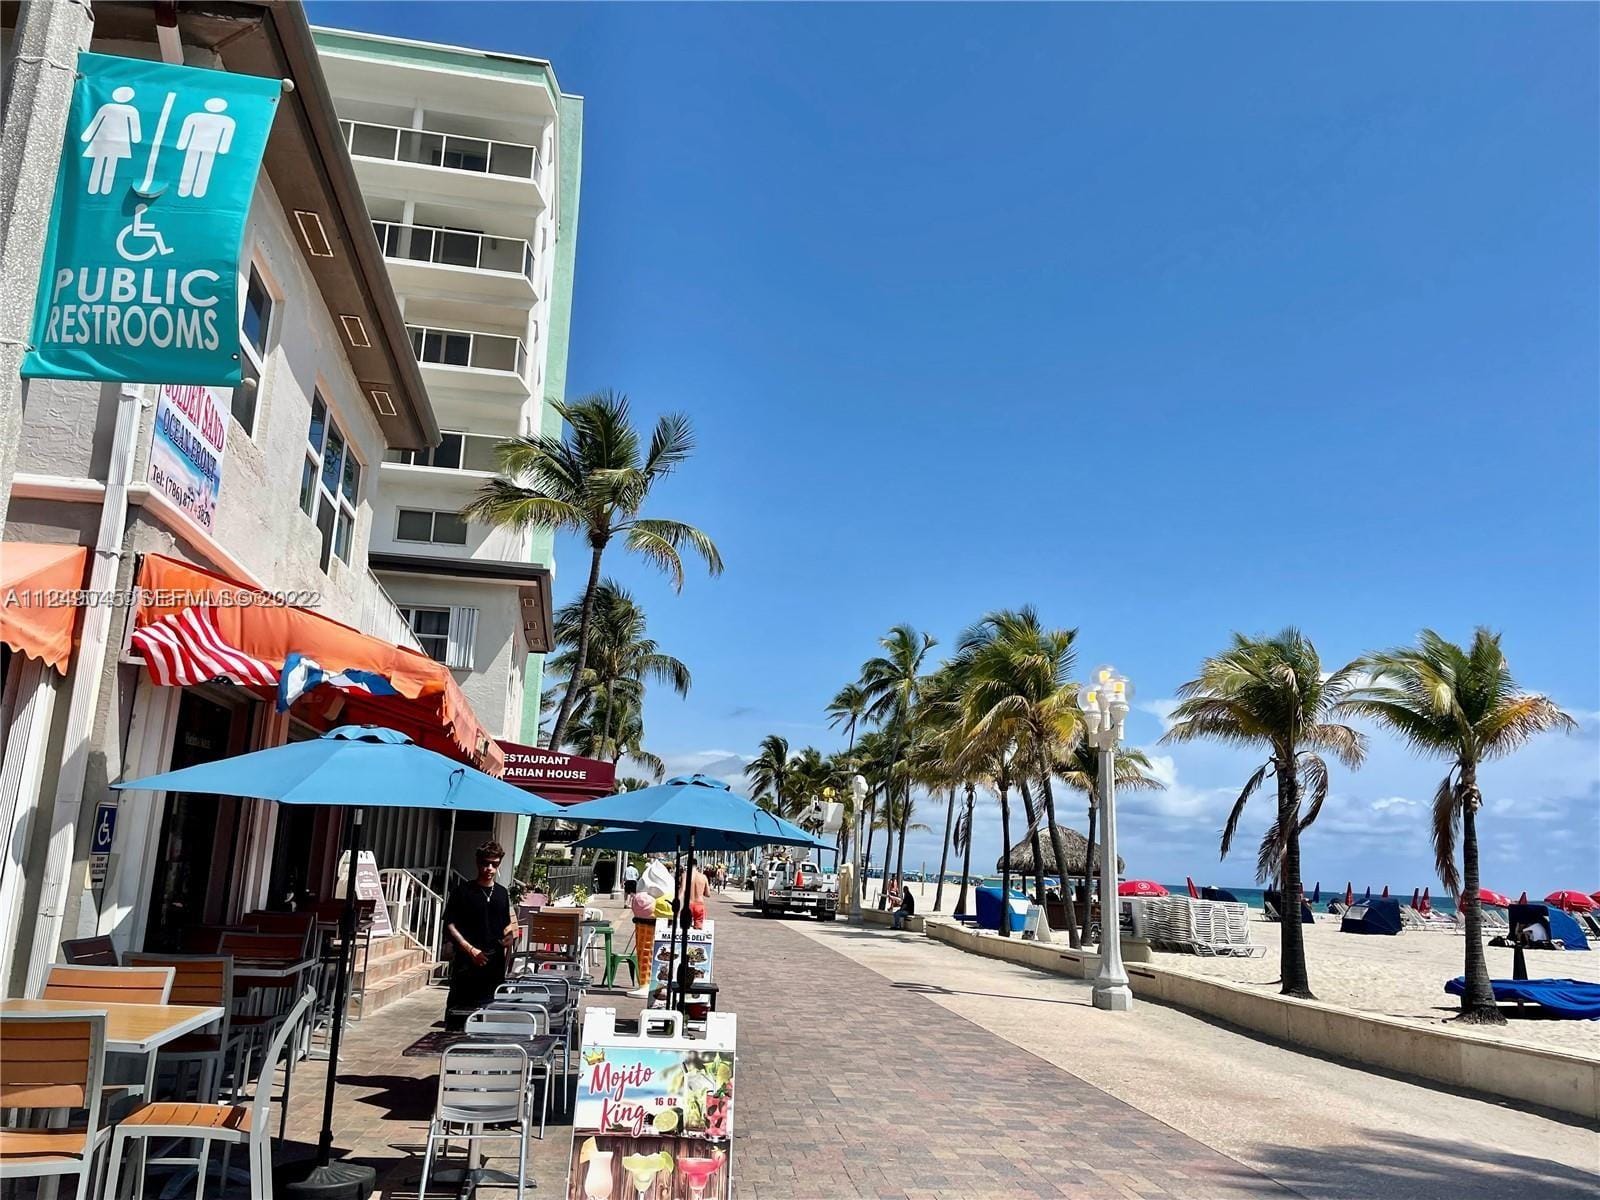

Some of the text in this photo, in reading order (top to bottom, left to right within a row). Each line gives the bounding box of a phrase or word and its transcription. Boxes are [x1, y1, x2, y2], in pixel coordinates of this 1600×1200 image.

[53, 267, 220, 307] PUBLIC
[44, 305, 219, 351] RESTROOMS
[163, 407, 193, 457] OCEAN
[201, 394, 225, 452] SAND
[153, 464, 165, 487] Tel:
[547, 770, 586, 779] HOUSE
[590, 1062, 654, 1101] Mojito
[601, 1098, 646, 1137] King
[655, 1098, 663, 1106] 16
